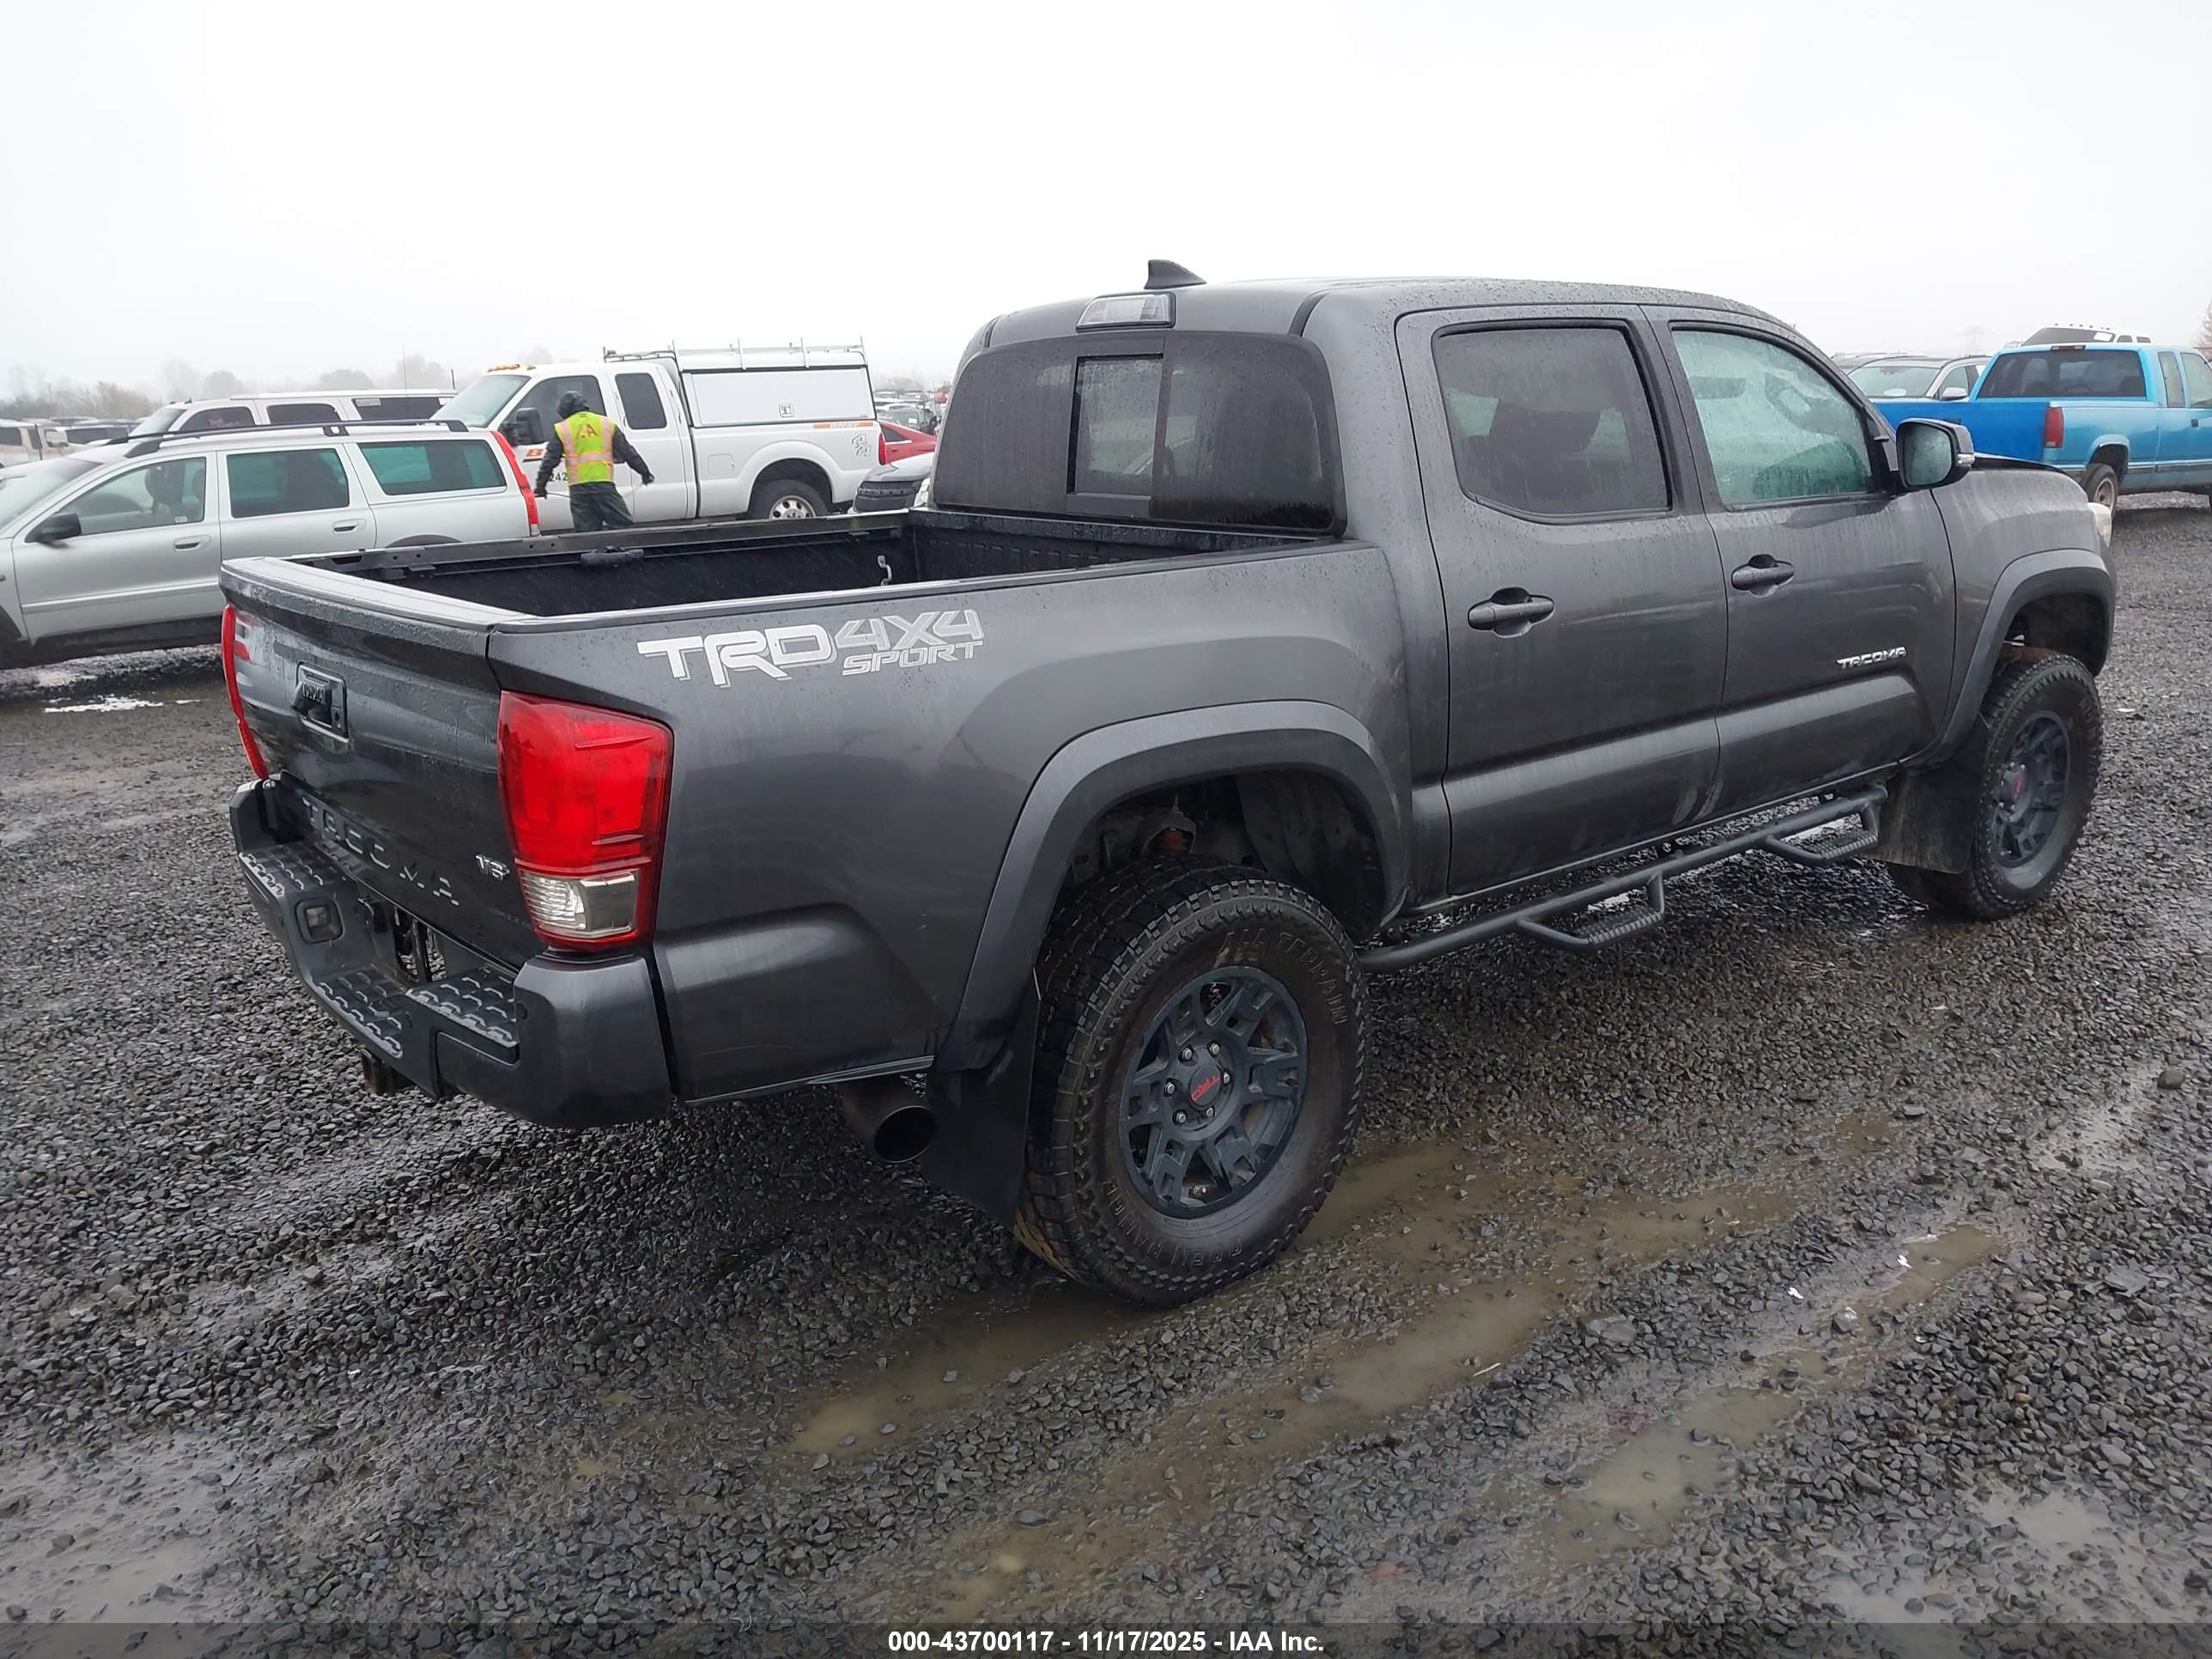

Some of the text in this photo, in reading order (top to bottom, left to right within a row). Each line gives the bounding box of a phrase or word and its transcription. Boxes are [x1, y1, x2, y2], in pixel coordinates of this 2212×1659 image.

[636, 624, 836, 688] TRD
[842, 641, 984, 676] SPORT
[1836, 646, 1907, 669] TACOMA
[301, 795, 460, 907] TACOMA
[474, 854, 510, 881] V6
